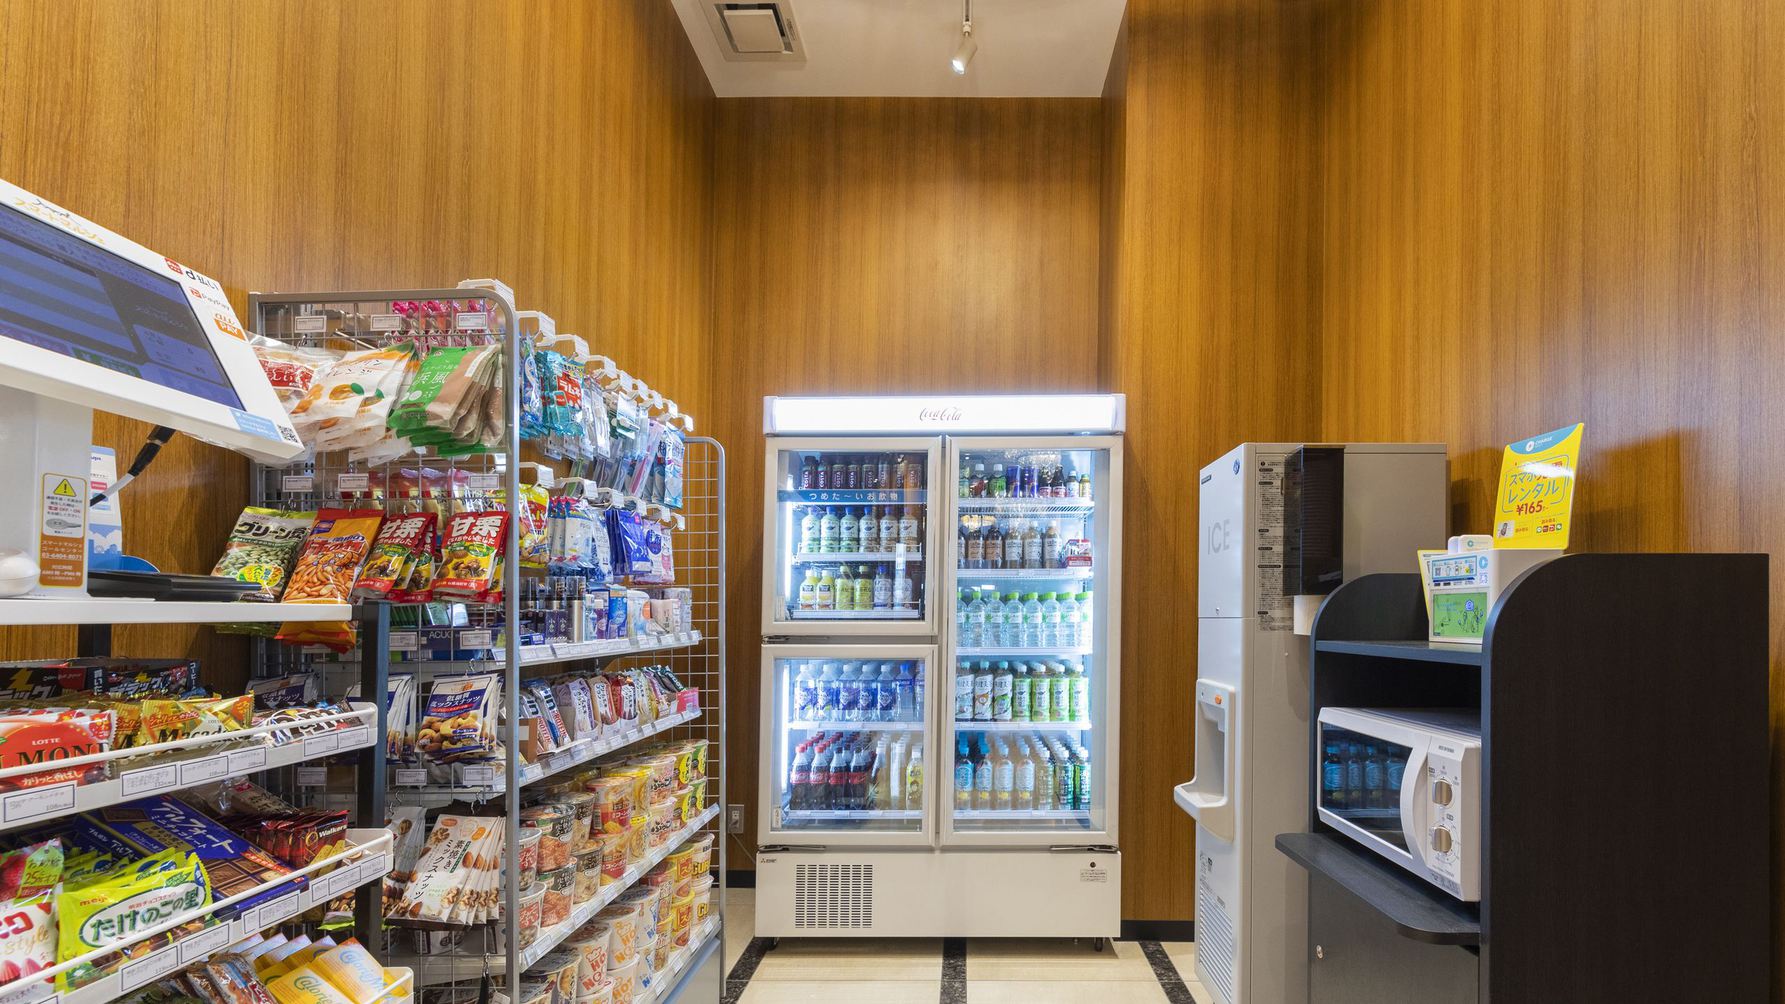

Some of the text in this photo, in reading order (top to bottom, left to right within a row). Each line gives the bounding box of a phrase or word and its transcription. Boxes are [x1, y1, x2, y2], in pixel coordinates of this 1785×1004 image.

[1508, 480, 1560, 504] レンタル
[378, 517, 427, 538] 甘栗
[451, 516, 503, 537] 甘栗
[1207, 519, 1230, 555] ICE
[430, 695, 481, 707] ミックスナッツ
[32, 737, 61, 747] LOTTE
[159, 725, 242, 744] Macad
[319, 825, 347, 838] Walkers
[443, 840, 465, 870] 素焼き
[414, 839, 454, 900] ミックスナッツ
[79, 894, 108, 907] meiji
[90, 886, 200, 942] たけのこの里
[5, 925, 50, 955] style
